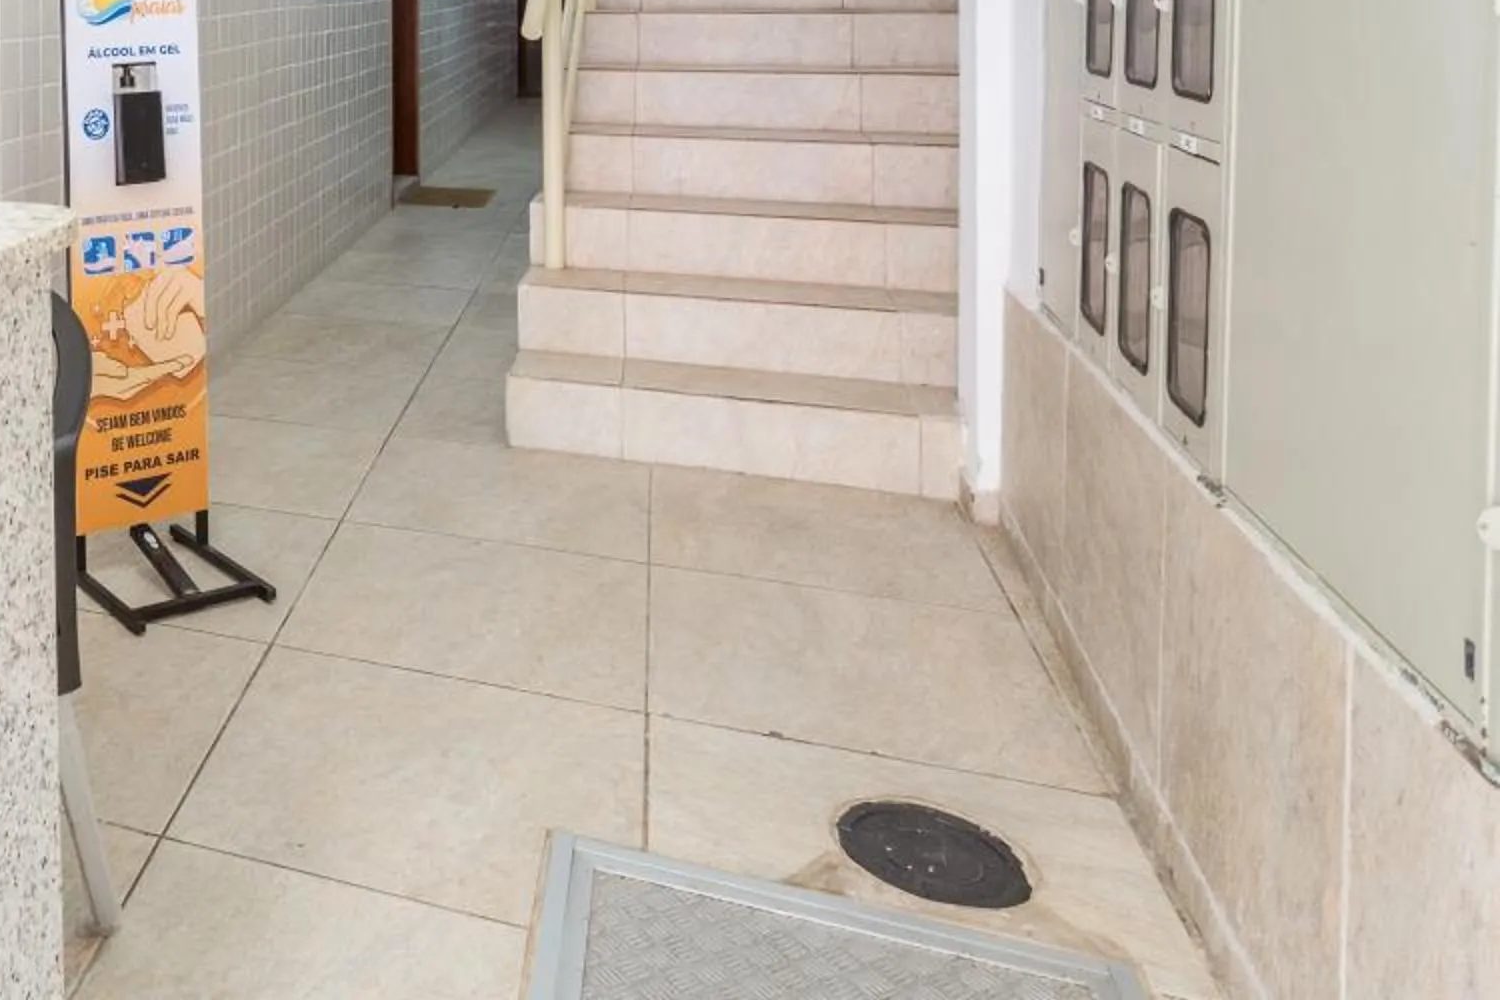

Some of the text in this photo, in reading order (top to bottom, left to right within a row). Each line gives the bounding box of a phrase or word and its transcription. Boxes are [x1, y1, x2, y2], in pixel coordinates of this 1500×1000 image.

[139, 45, 156, 56] EM
[160, 43, 181, 55] GEL
[129, 408, 151, 427] BEM
[152, 404, 187, 423] VINDOS
[111, 428, 172, 452] BE WELCOME
[85, 448, 200, 480] PISE PARA SAIR
